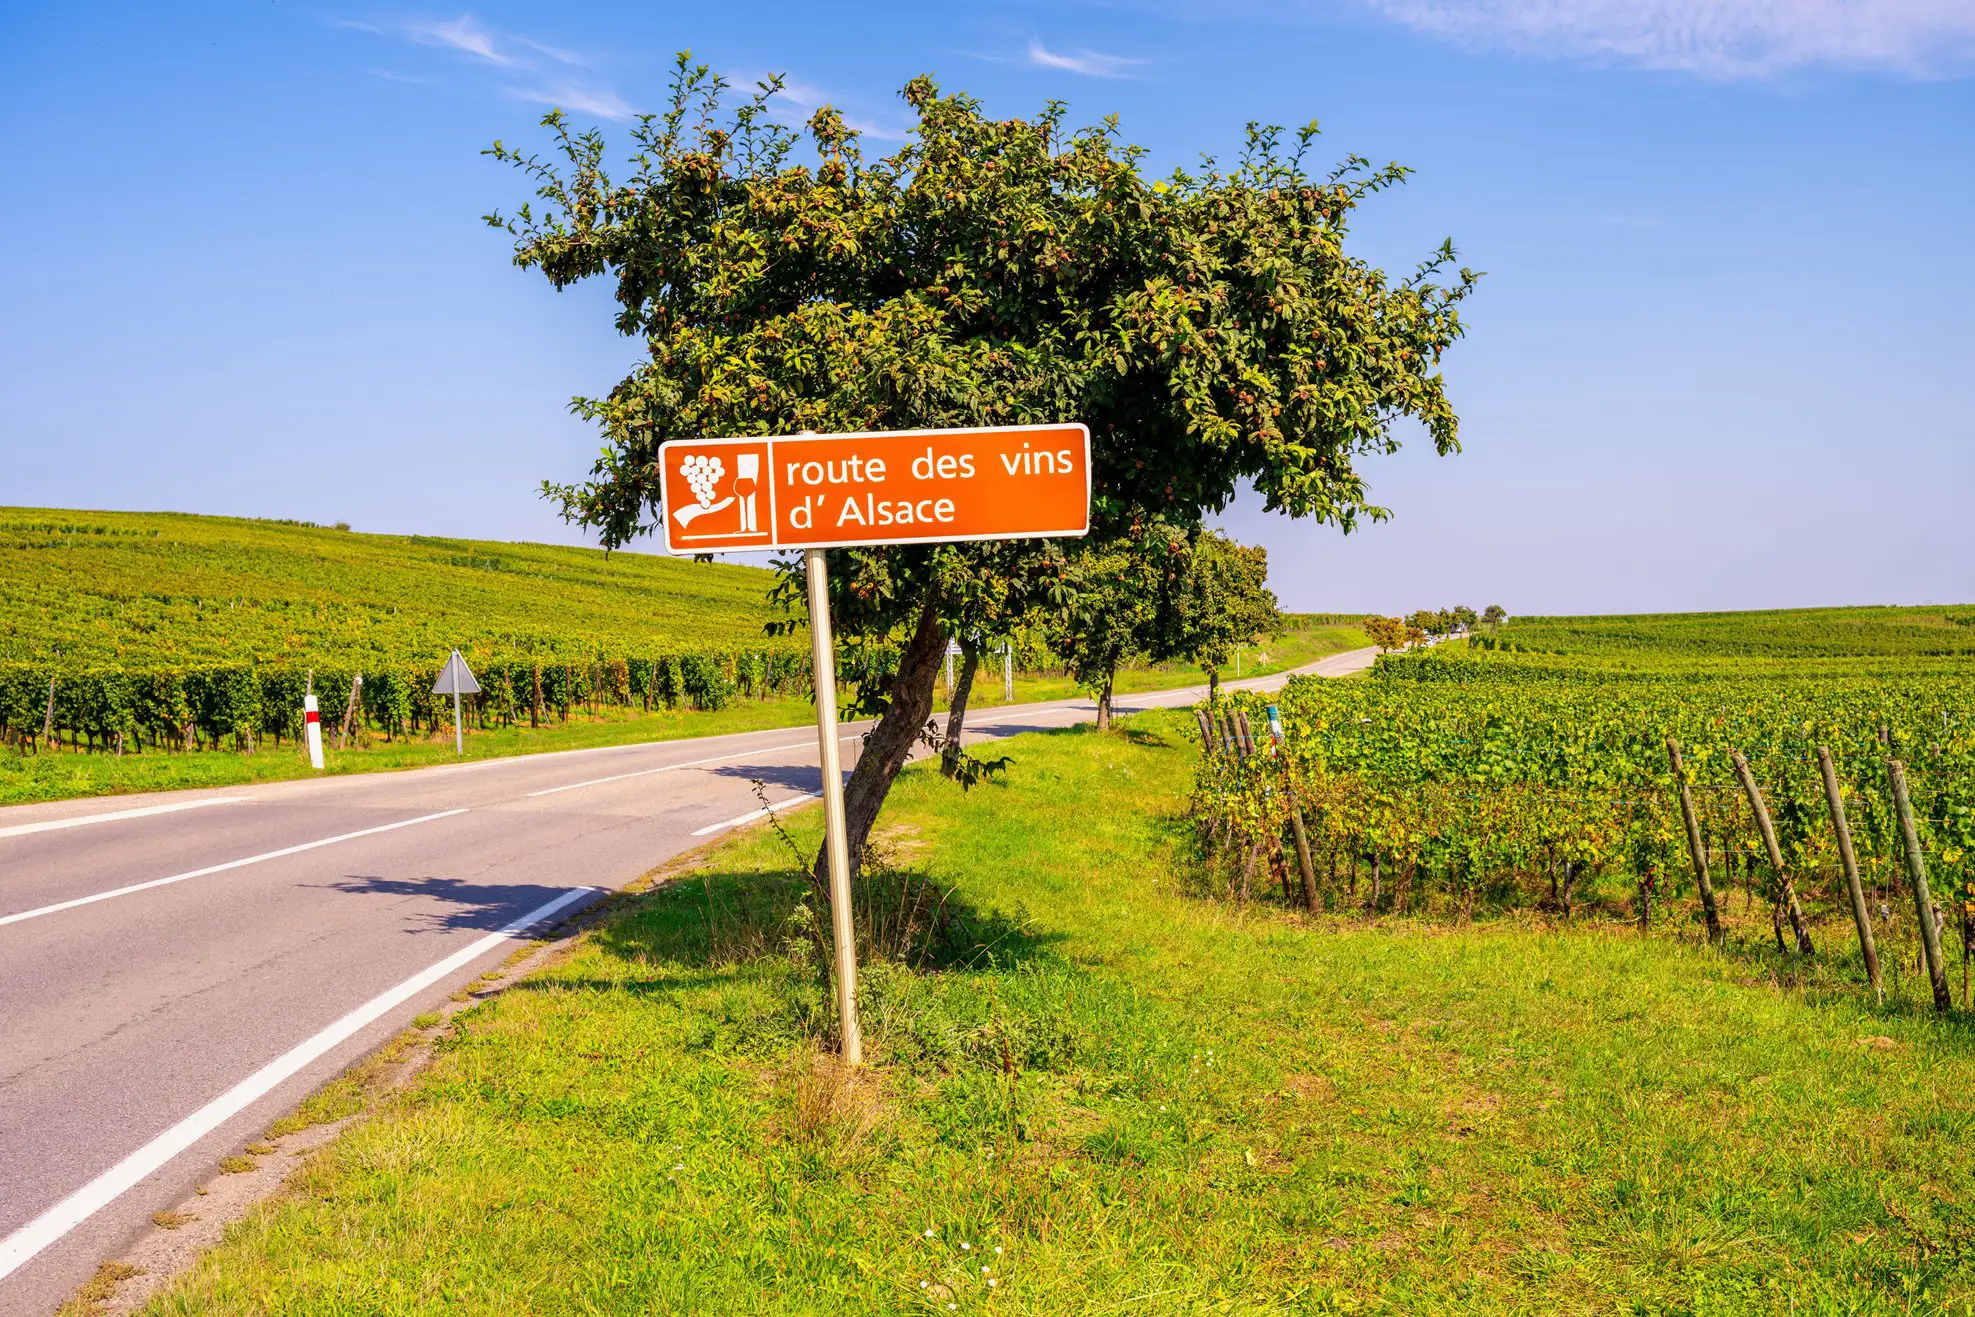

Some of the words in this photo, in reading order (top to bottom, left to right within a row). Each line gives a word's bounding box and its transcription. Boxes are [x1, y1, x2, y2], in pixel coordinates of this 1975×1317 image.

[787, 454, 886, 486] route
[911, 447, 975, 480] des
[1000, 442, 1073, 476] vins
[836, 494, 955, 526] Alsace
